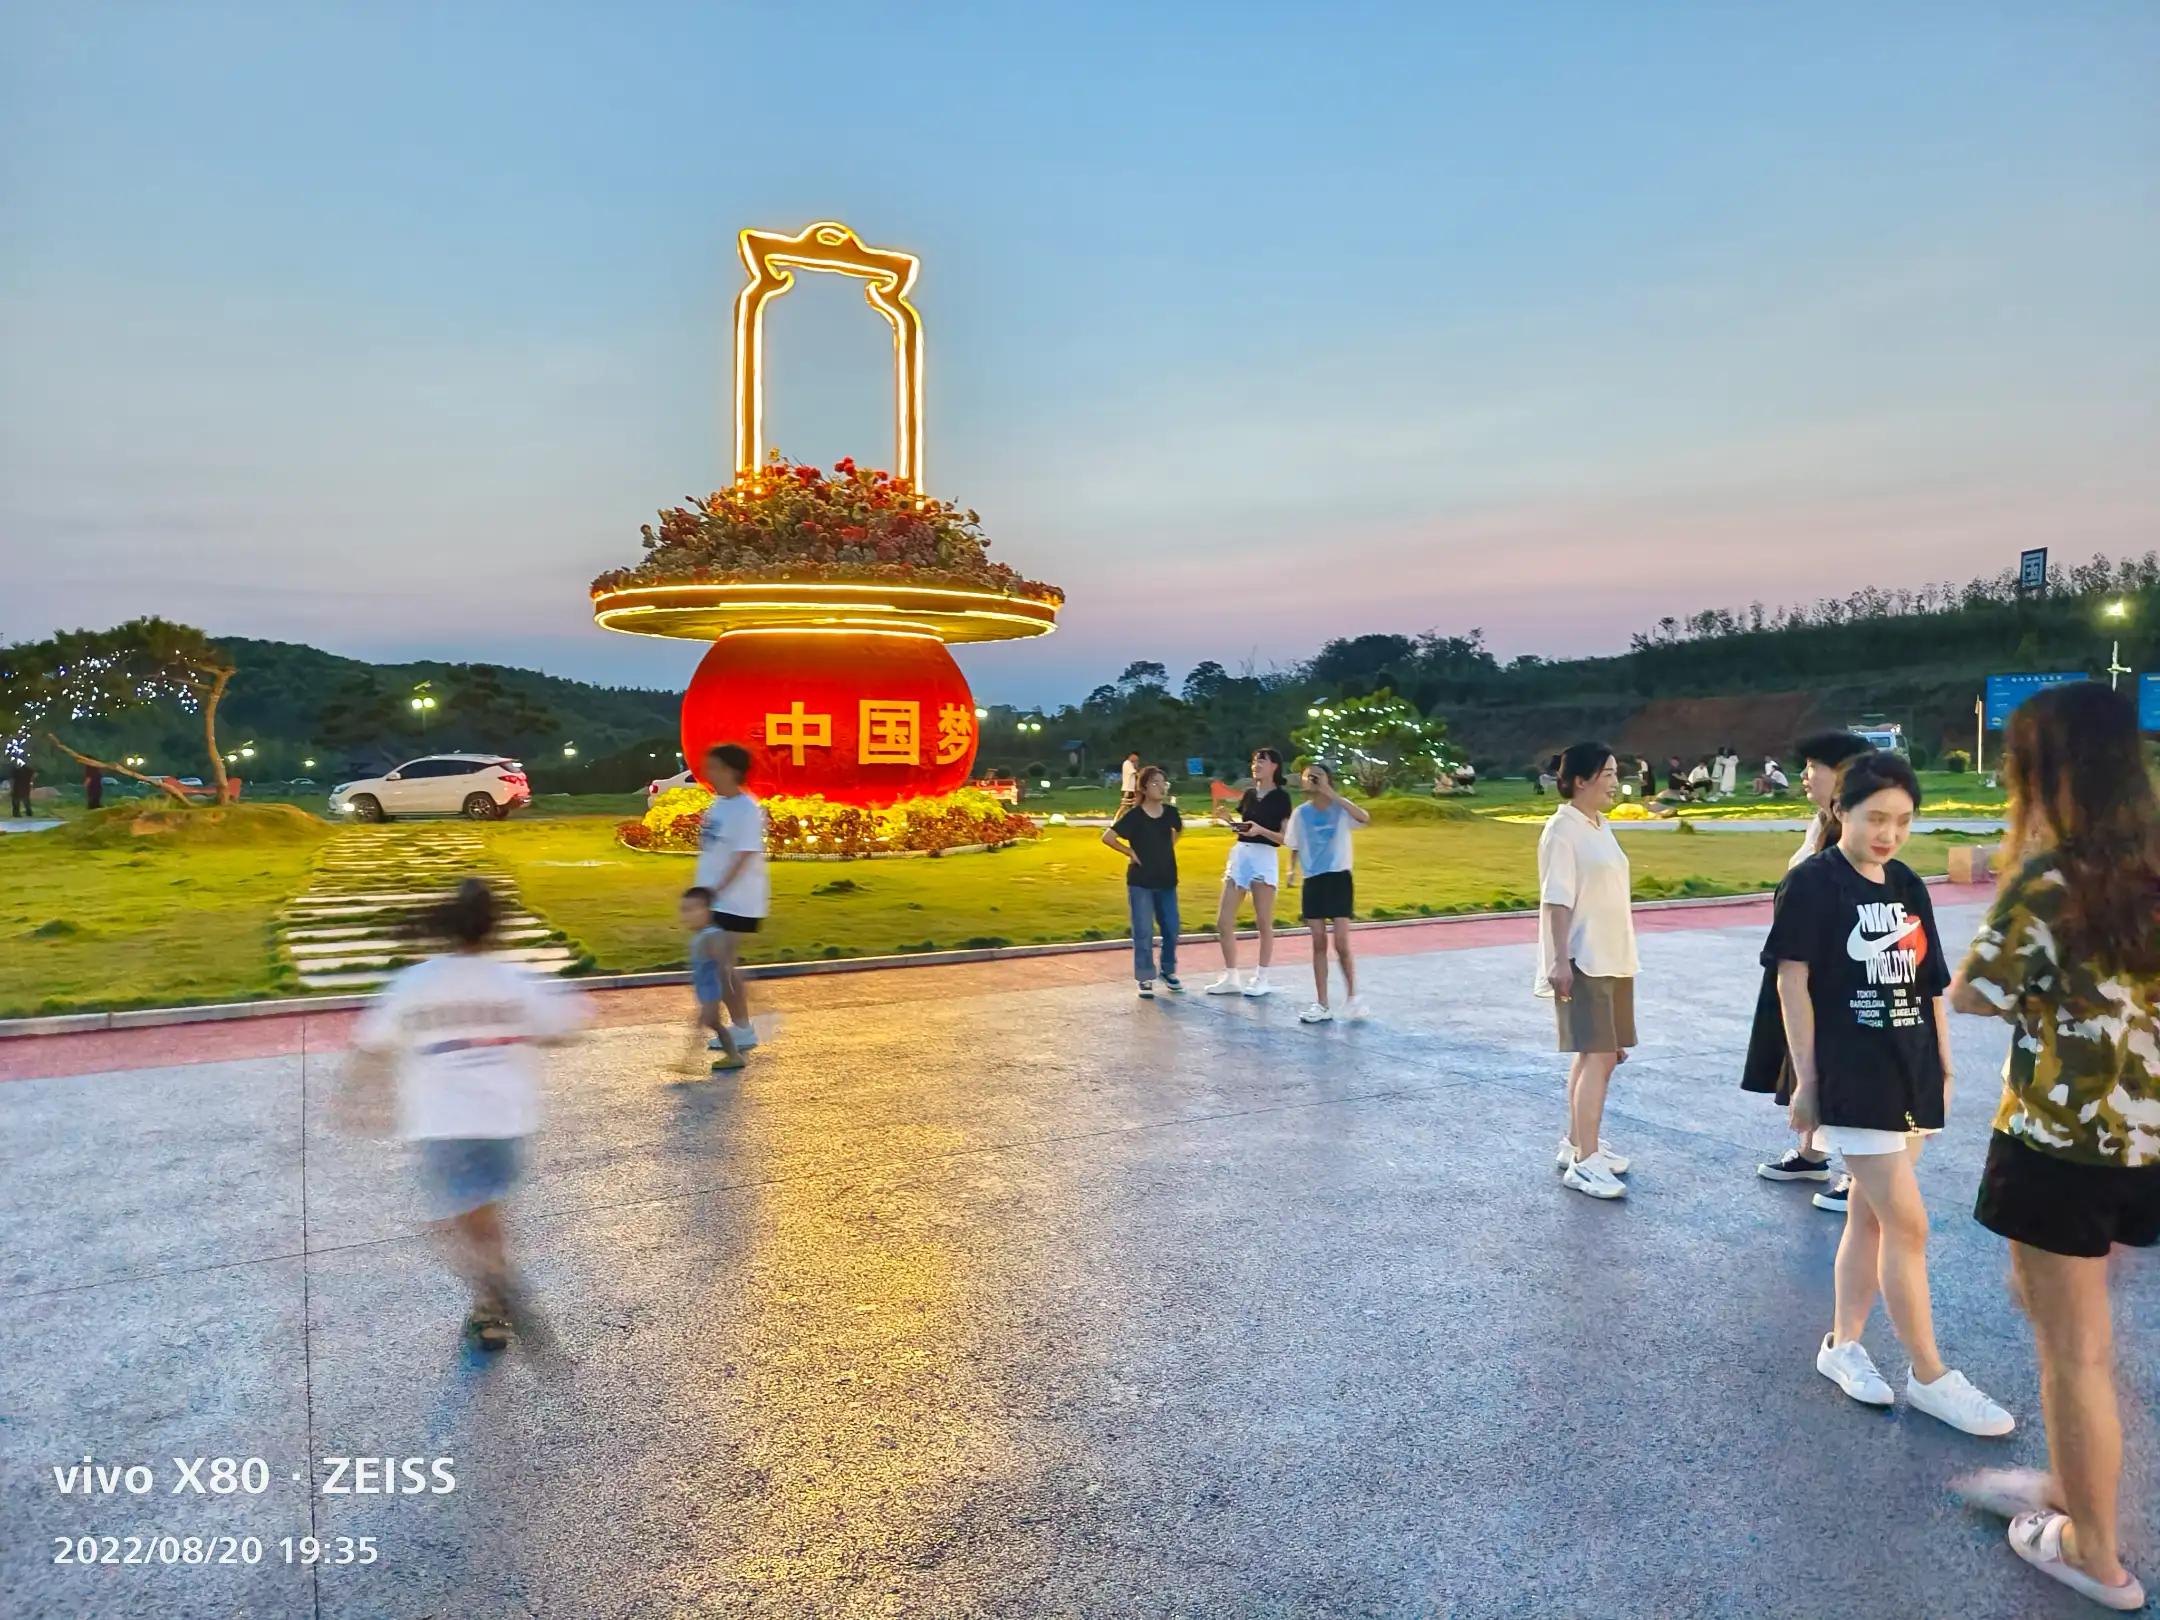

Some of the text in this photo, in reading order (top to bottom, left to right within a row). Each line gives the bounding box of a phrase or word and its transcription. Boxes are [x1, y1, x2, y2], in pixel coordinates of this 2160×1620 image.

[765, 700, 973, 766] 中国梦
[1856, 902, 1908, 933] NIKE
